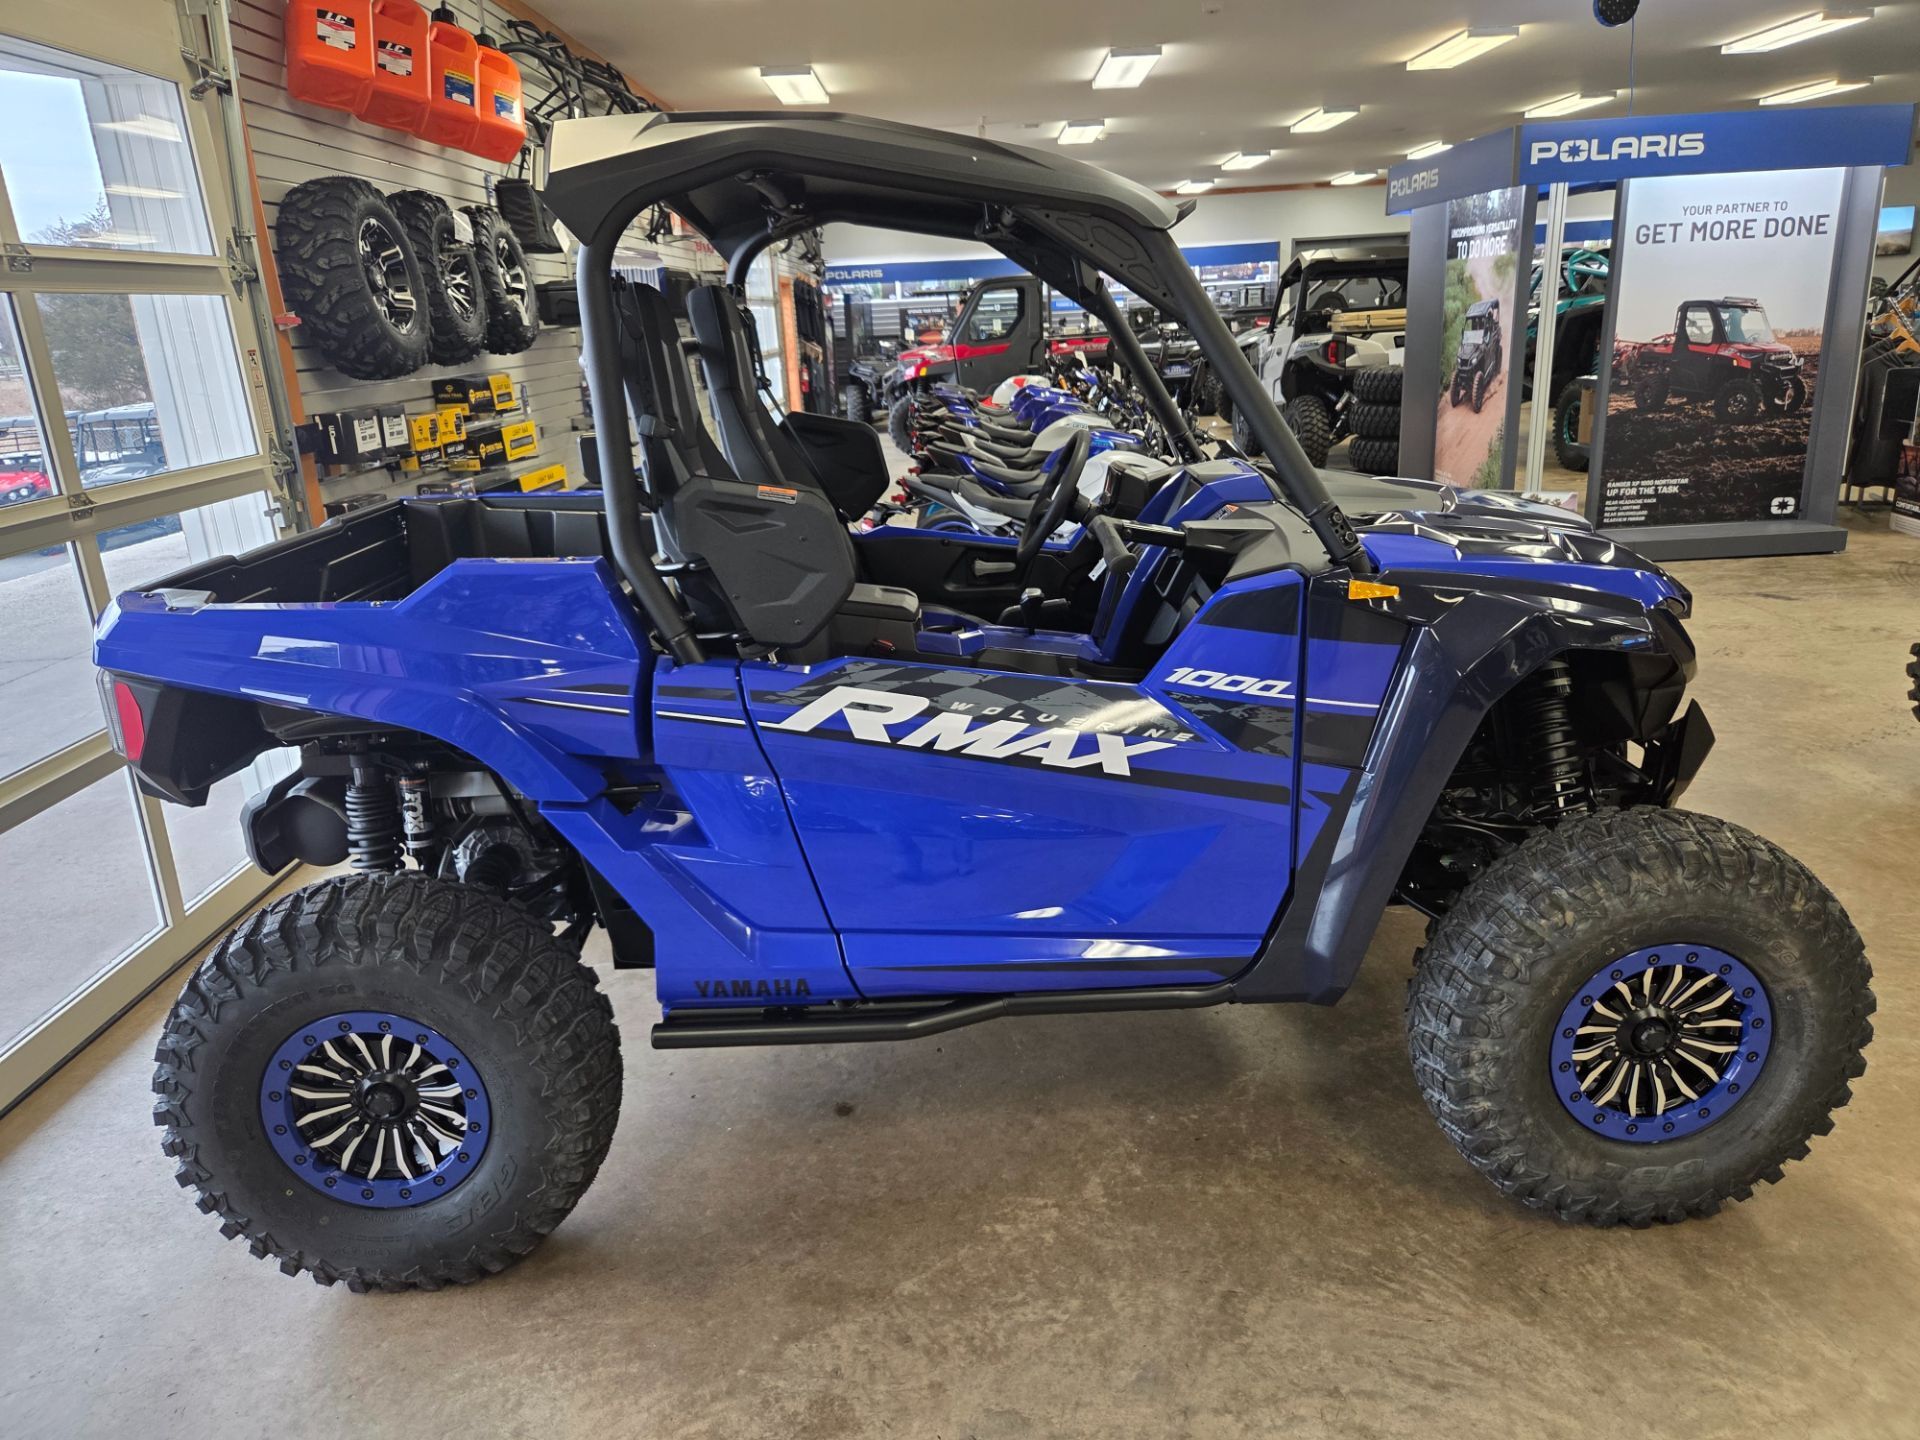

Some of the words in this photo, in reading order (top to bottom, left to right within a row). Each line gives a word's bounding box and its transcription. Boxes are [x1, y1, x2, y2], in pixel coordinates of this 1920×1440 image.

[325, 12, 347, 24] LC
[386, 42, 405, 53] LC
[1530, 132, 1704, 165] POLARIS
[1389, 168, 1439, 199] POLARIS
[1682, 203, 1712, 216] YOUR
[1716, 201, 1769, 214] PARTNER
[1774, 200, 1788, 212] TO
[1635, 222, 1683, 245] GET
[1690, 218, 1757, 242] MORE
[1764, 214, 1830, 239] DONE
[1457, 241, 1467, 260] TO
[1469, 239, 1480, 259] DO
[1482, 235, 1508, 257] MORE
[825, 269, 883, 281] POLARIS
[1606, 489, 1619, 497] UP
[1619, 488, 1637, 496] FOR
[1638, 486, 1655, 495] THE
[1657, 485, 1680, 494] TASK
[1164, 666, 1294, 699] 1000
[780, 686, 1178, 777] RMAX
[403, 791, 424, 832] FOX
[694, 978, 812, 998] YAMAHA
